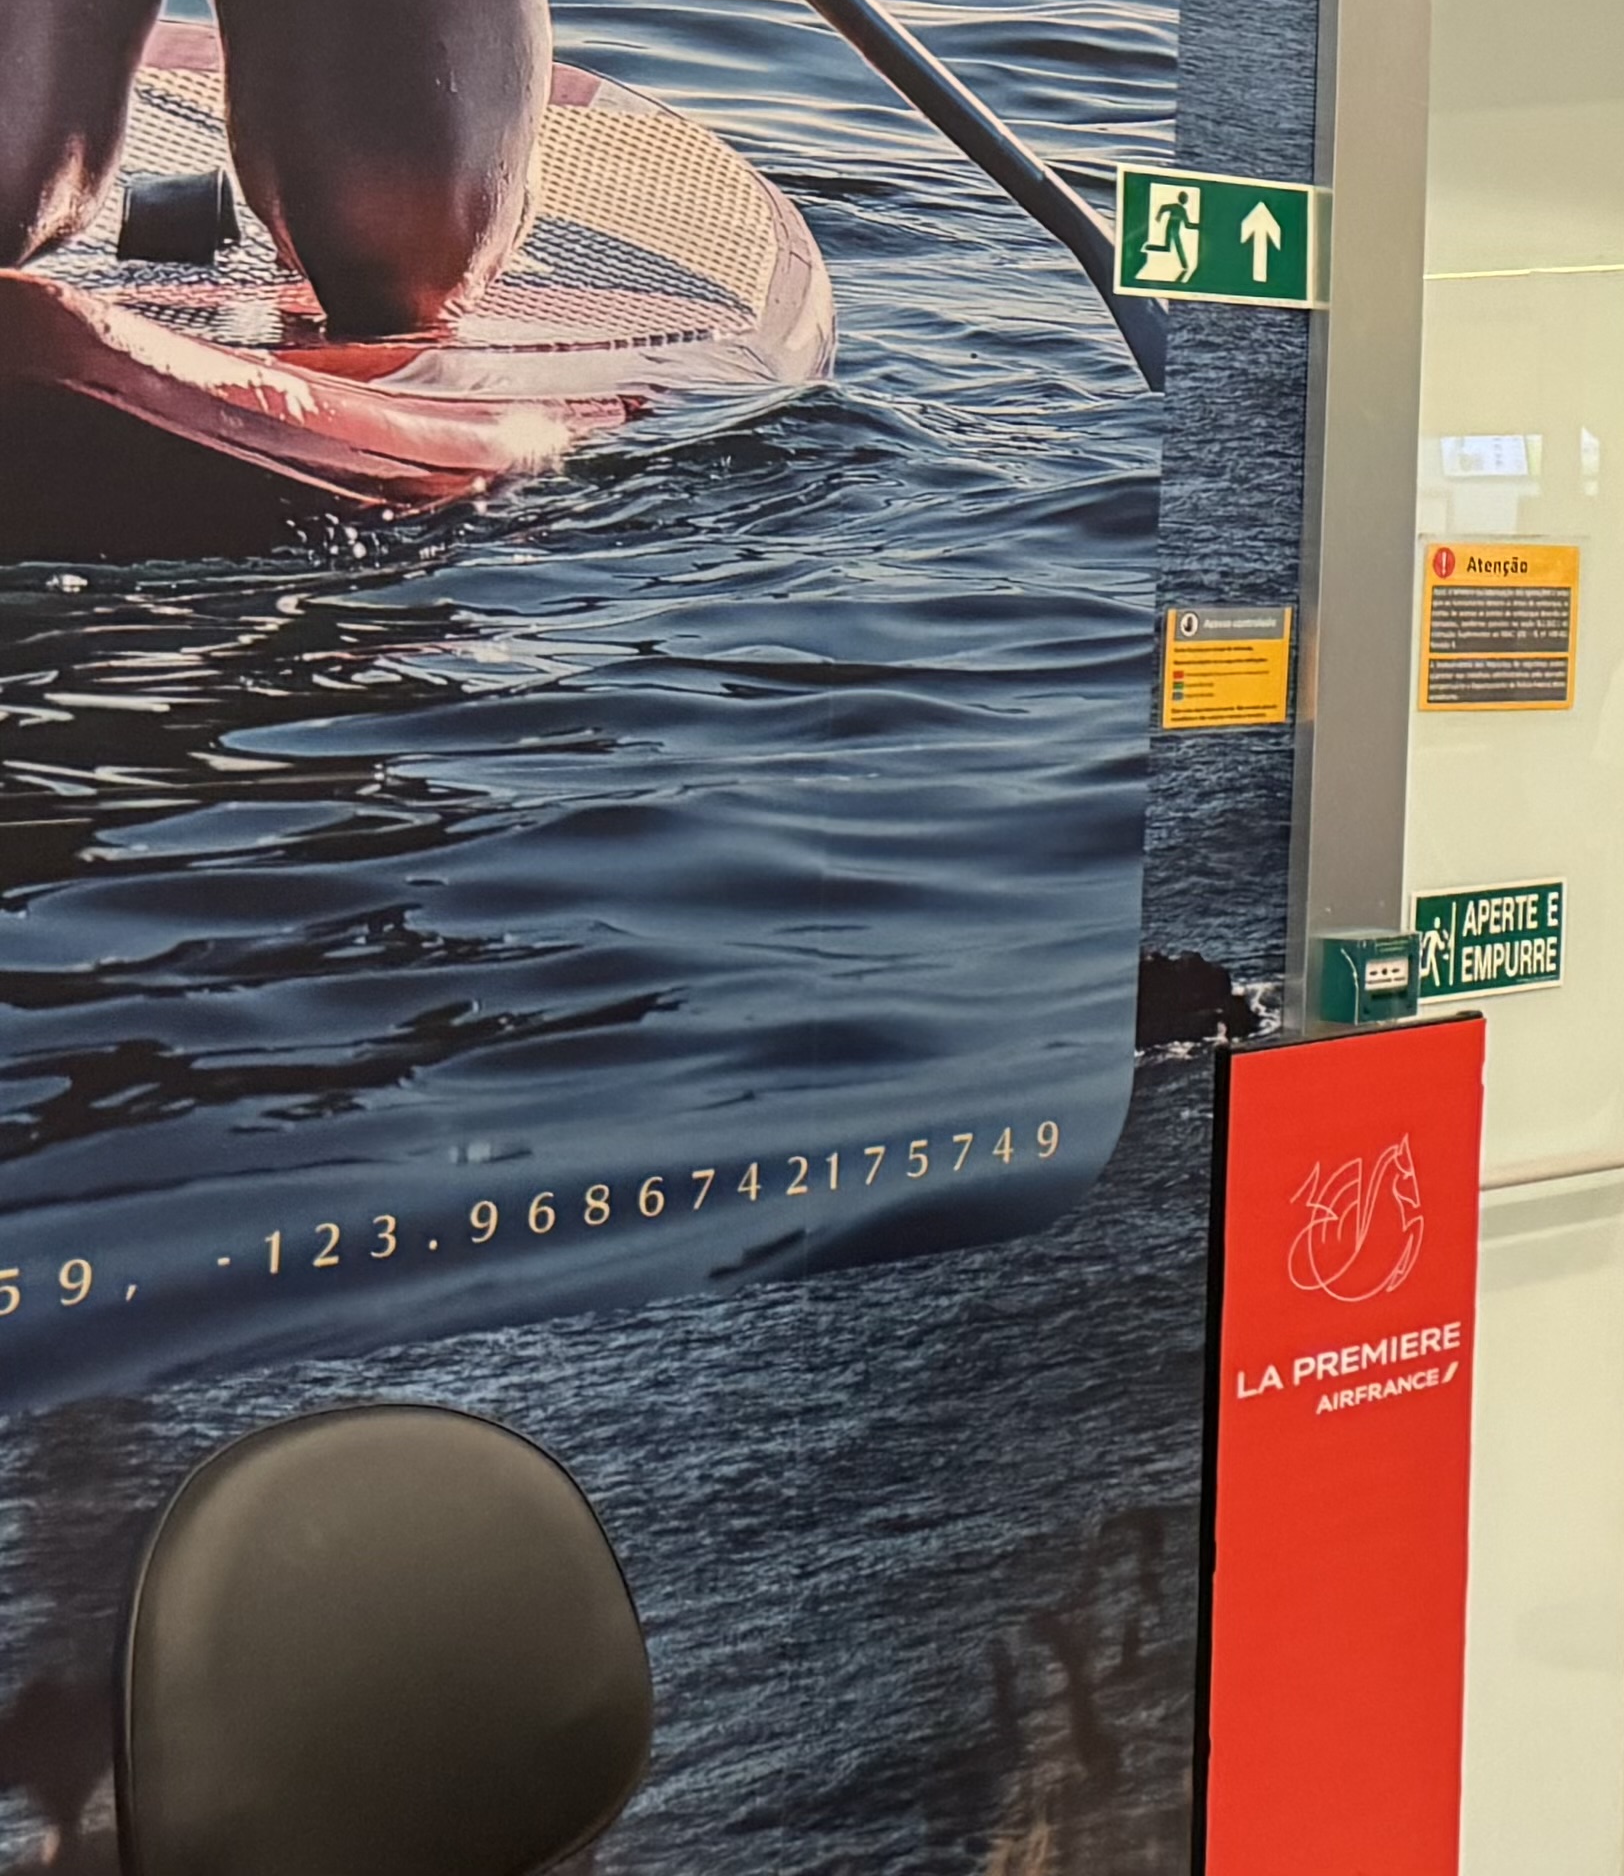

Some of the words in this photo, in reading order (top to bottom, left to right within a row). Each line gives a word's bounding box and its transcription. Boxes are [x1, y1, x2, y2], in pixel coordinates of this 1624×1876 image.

[1466, 557, 1528, 577] Atenção
[1462, 893, 1539, 937] APERTE
[1547, 891, 1559, 927] E
[1461, 936, 1558, 983] EMPURRE
[1236, 1365, 1283, 1399] LA
[1293, 1321, 1462, 1387] PREMIERE
[1316, 1367, 1440, 1415] AIRFRANCE
